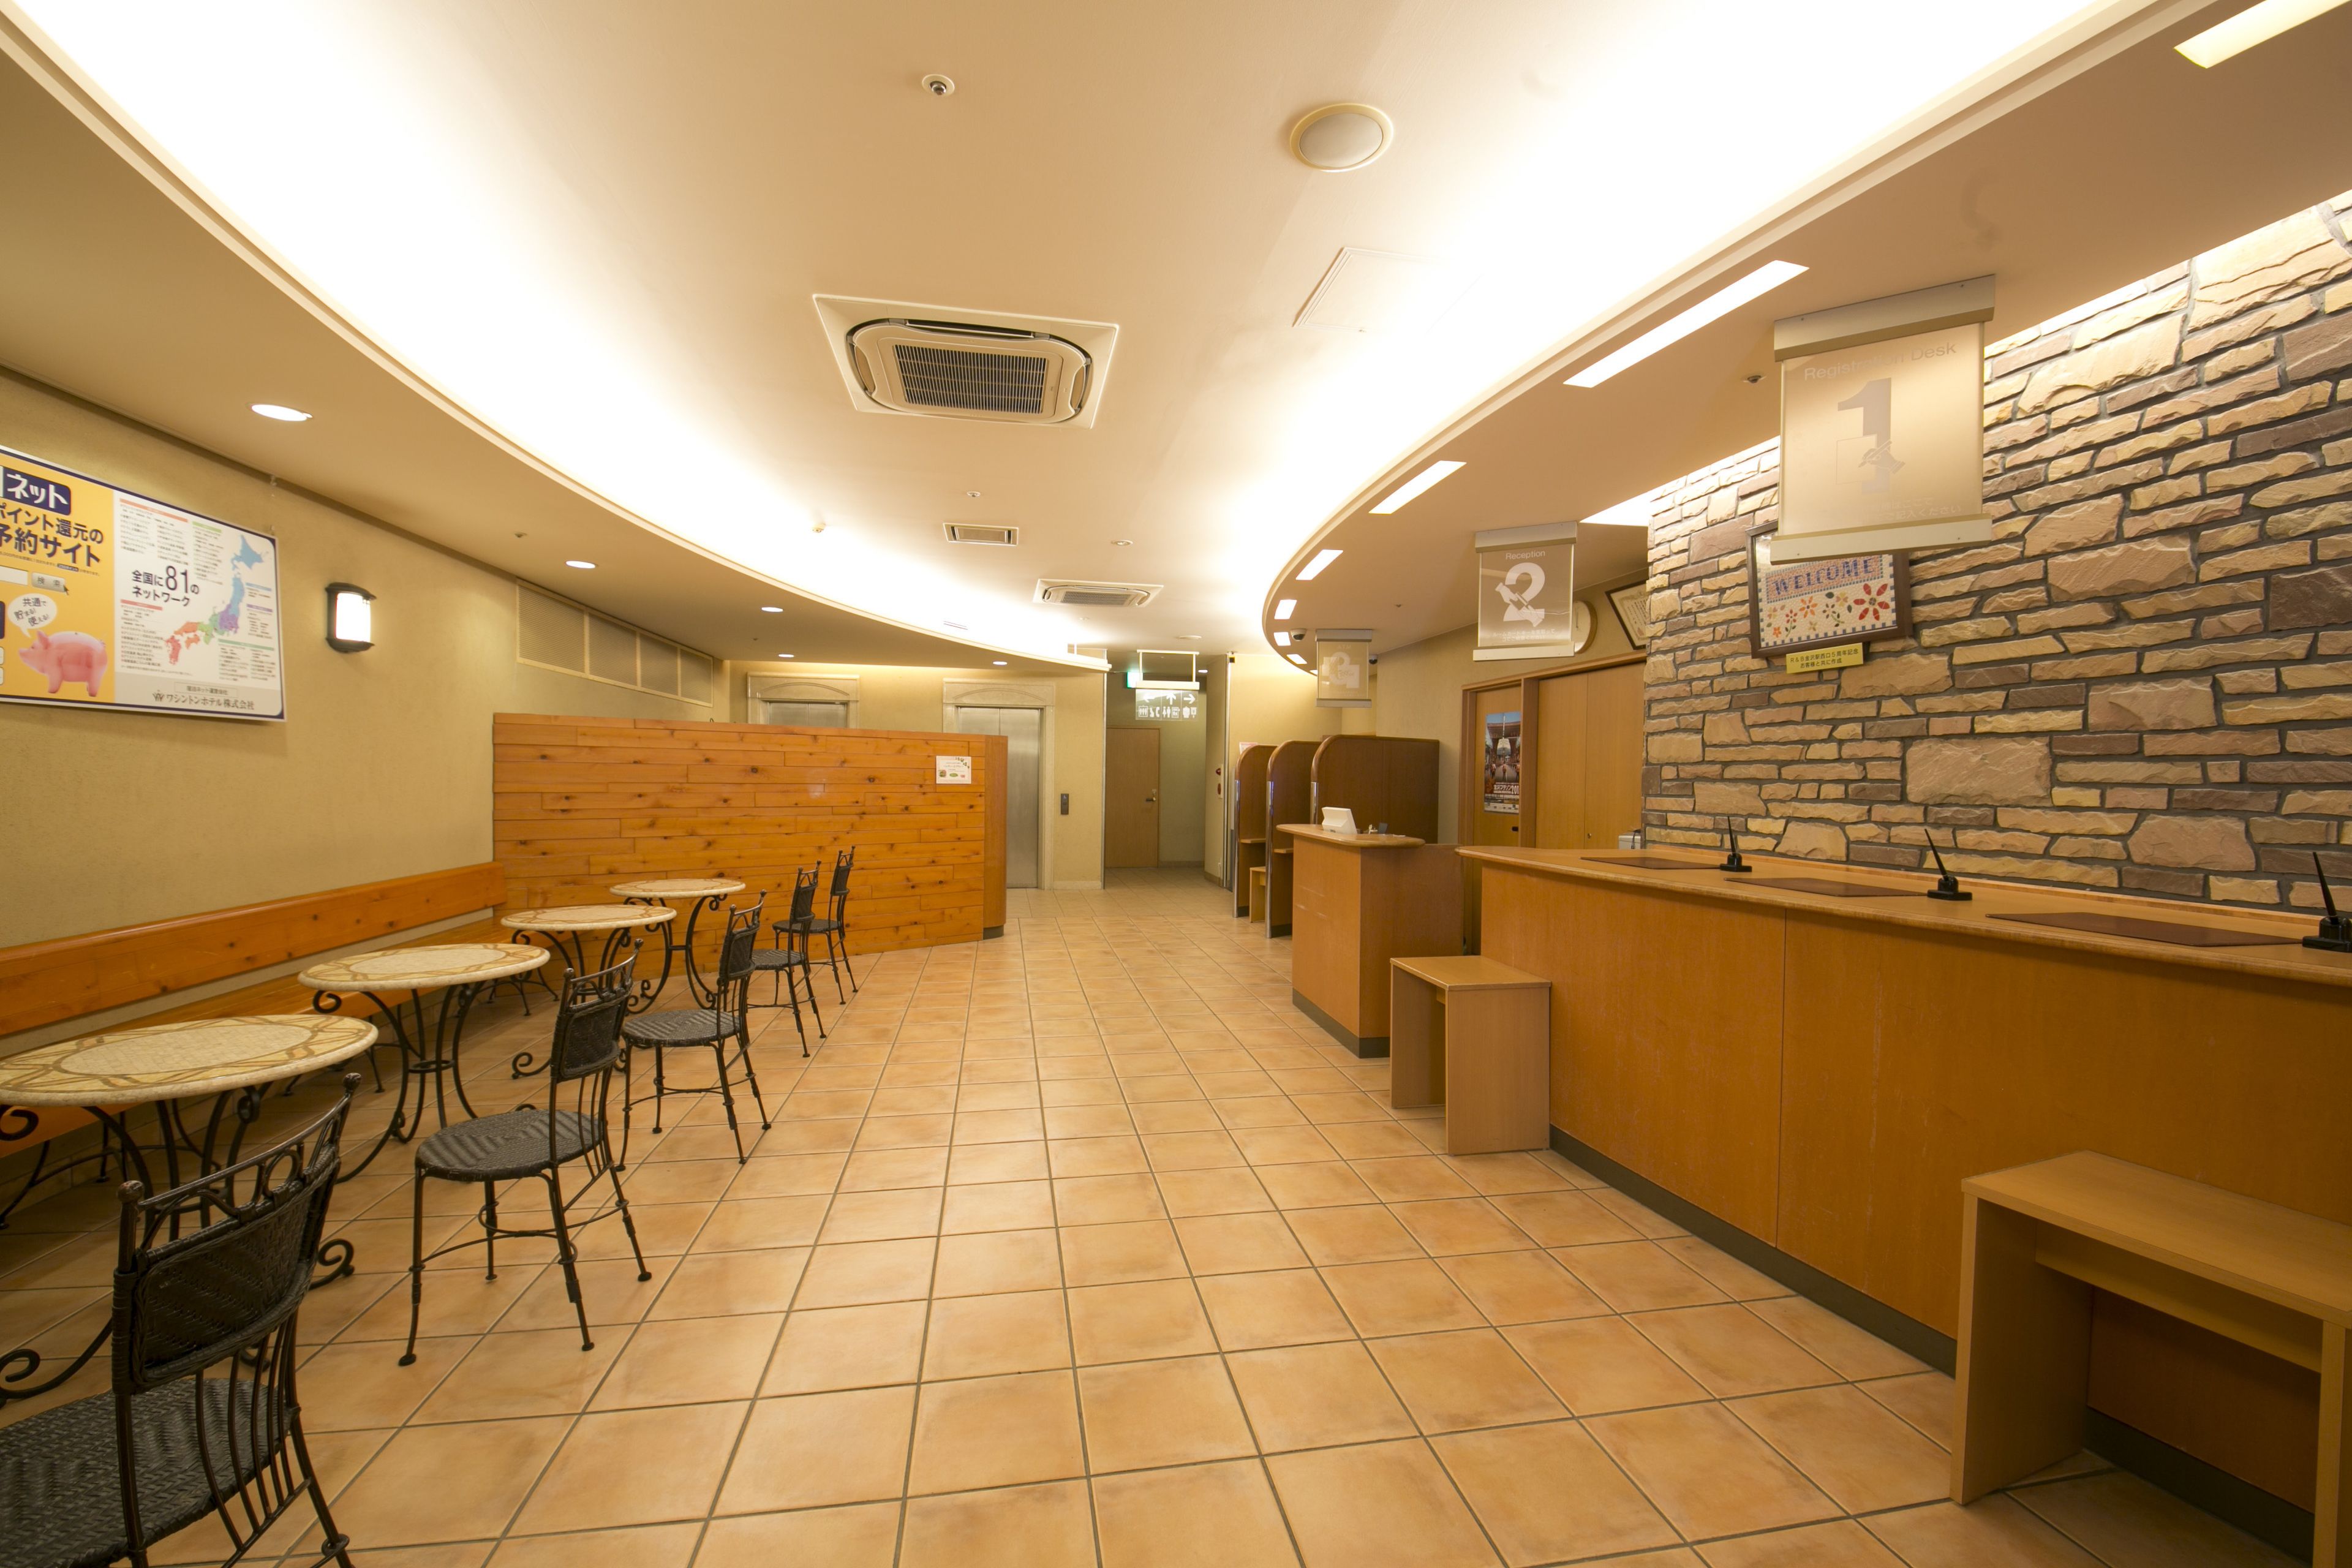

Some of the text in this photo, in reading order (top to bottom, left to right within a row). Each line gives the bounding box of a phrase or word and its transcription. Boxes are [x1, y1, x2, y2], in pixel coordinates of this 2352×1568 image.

[1804, 342, 1957, 381] Registration Desk
[1505, 550, 1546, 560] Reception
[132, 565, 200, 595] 全国に81の
[1771, 557, 1875, 595] WELCOME
[132, 586, 190, 606] ネットワーク
[166, 694, 255, 710] ワシントンホテル株式会社
